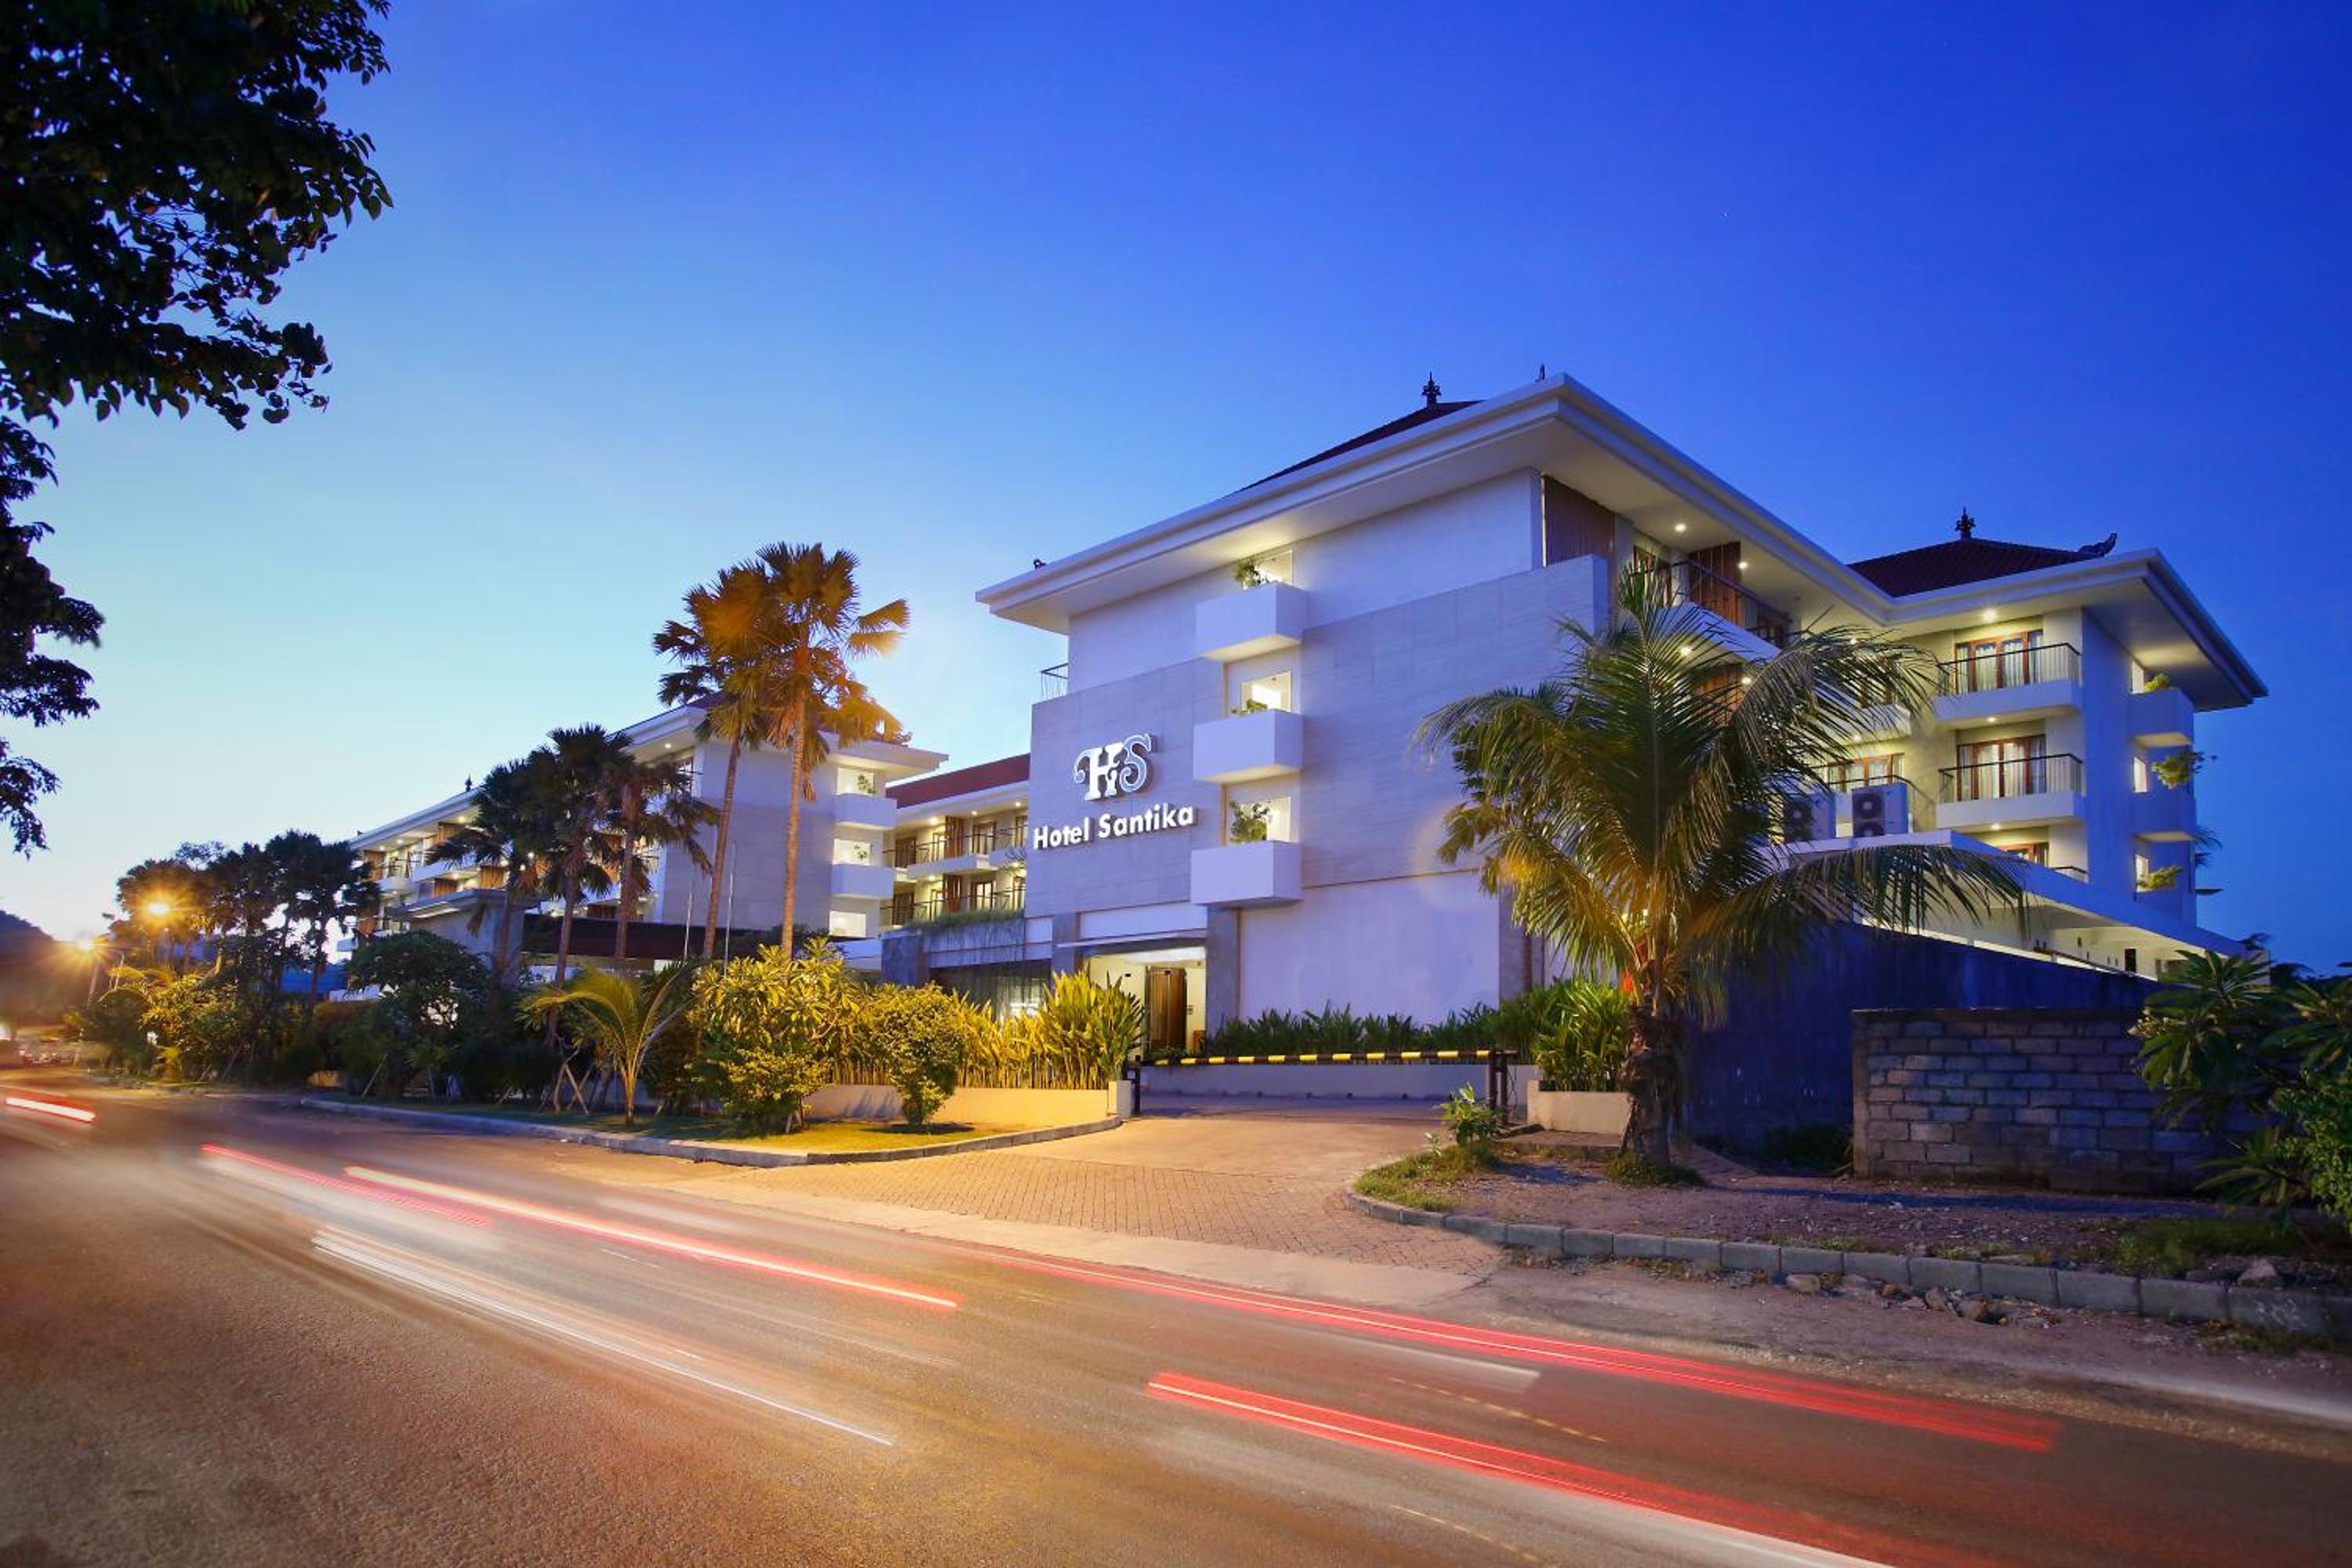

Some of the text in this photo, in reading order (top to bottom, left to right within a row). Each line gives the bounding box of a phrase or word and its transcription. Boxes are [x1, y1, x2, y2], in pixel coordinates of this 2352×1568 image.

[1074, 733, 1152, 800] HS
[1033, 803, 1194, 850] Hotel Santika
